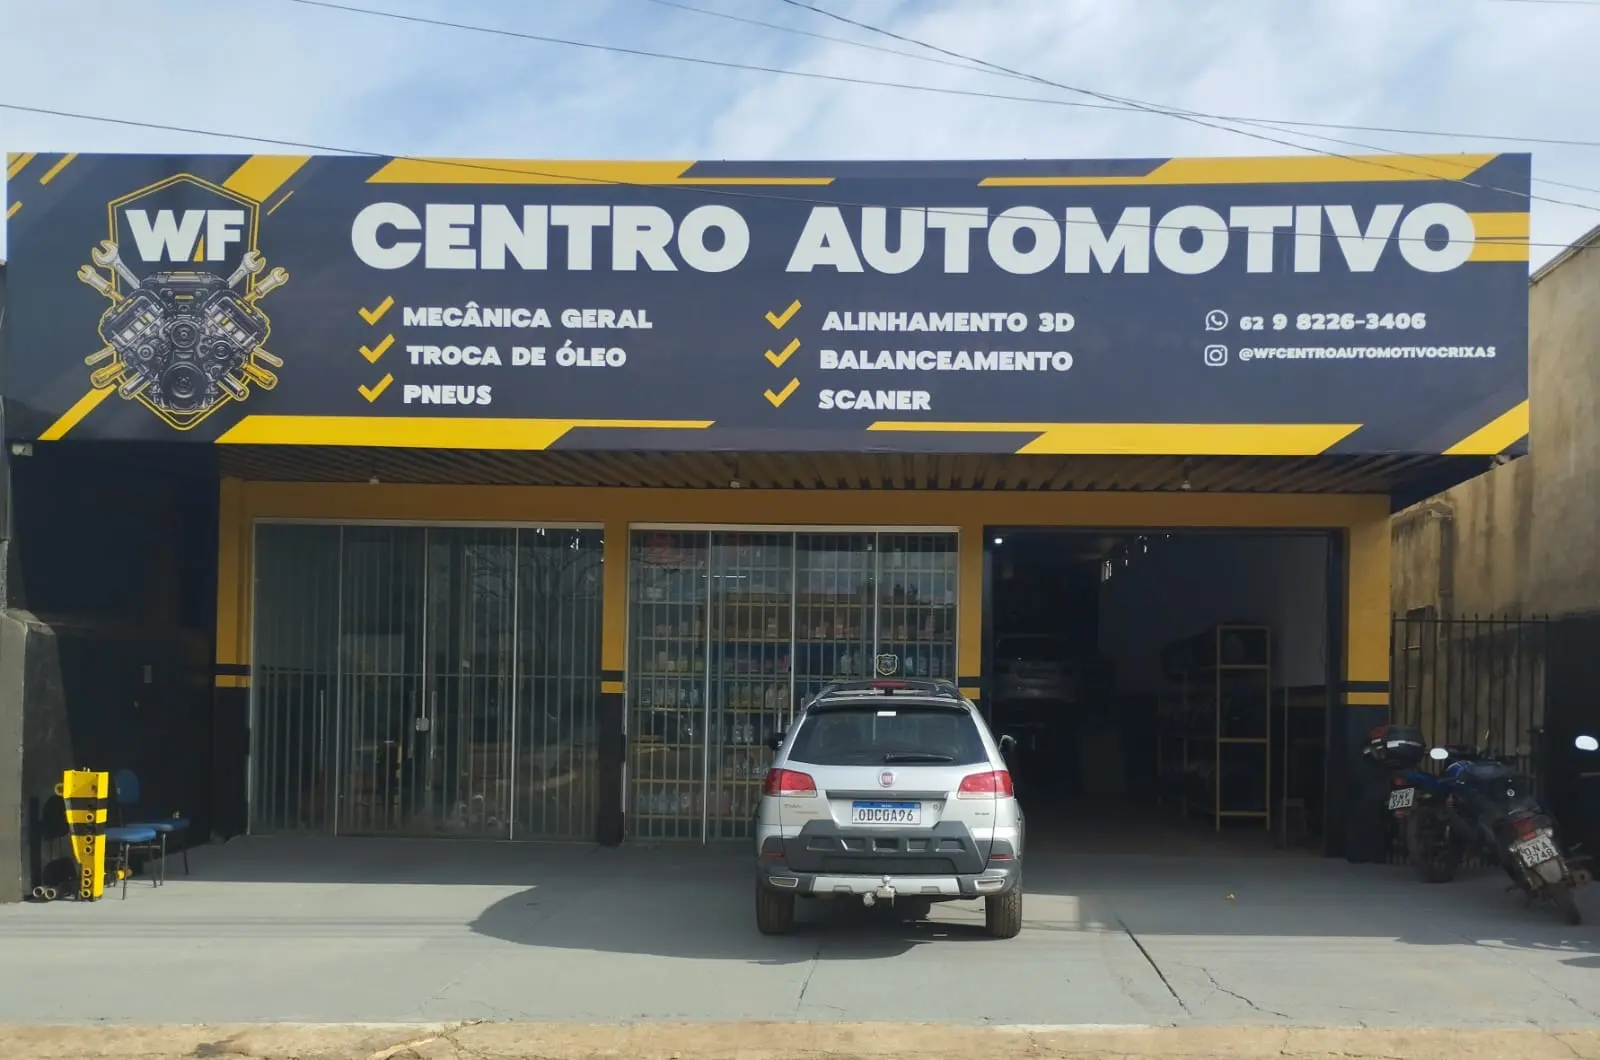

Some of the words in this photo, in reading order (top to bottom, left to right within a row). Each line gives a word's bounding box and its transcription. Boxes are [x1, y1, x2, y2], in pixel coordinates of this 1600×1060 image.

[125, 209, 245, 262] WF
[352, 202, 749, 272] CENTRO
[786, 204, 1475, 274] AUTOMOTIVO
[404, 301, 551, 327] MECÂNICA
[561, 309, 652, 328] GERAL
[822, 312, 1027, 332] ALINHAMENTO
[1039, 313, 1074, 332] 3D
[1240, 316, 1264, 330] 62
[1273, 314, 1287, 330] 9
[1296, 313, 1426, 330] 8226-3406
[407, 346, 502, 365] TROCA
[512, 347, 546, 365] DE
[556, 339, 626, 367] ÓLEO
[820, 350, 1073, 371] BALANCEAMENTO
[1239, 346, 1496, 361] @WFCENTROAUTOMOTIVOCRIXAS
[404, 385, 491, 404] PNEUS
[819, 390, 931, 410] SCANER
